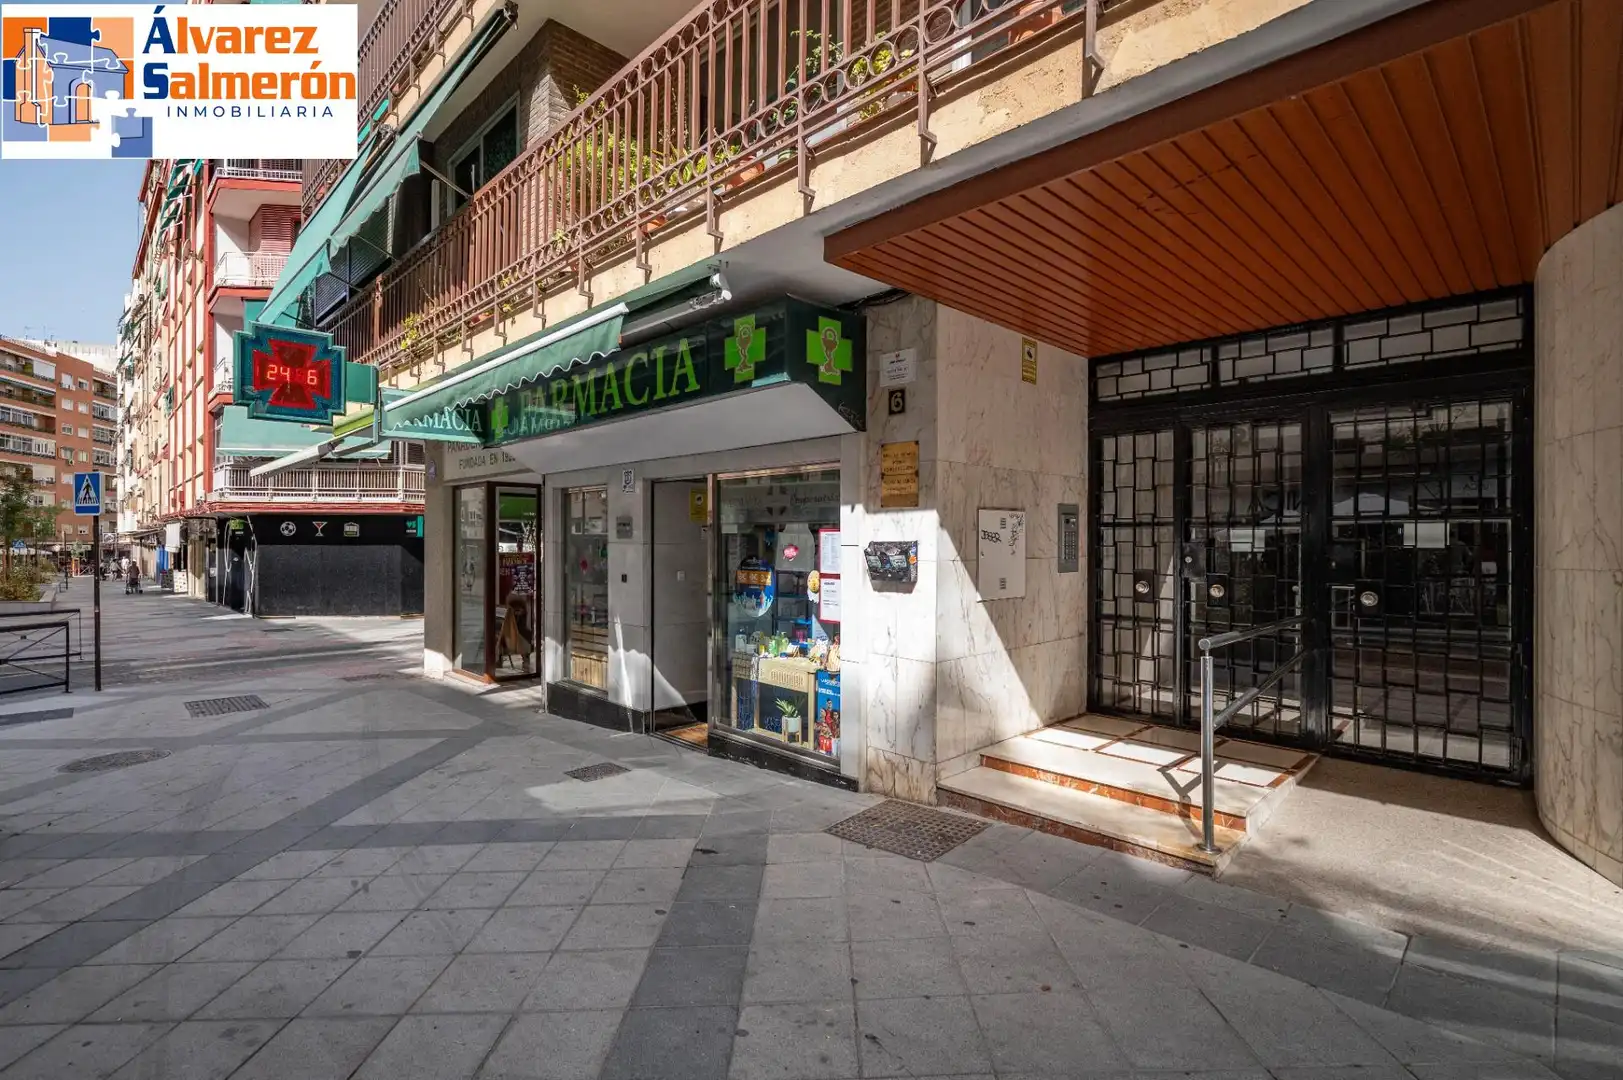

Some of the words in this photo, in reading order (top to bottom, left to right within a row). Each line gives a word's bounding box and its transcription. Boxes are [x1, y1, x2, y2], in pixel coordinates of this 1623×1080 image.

[266, 364, 290, 383] 24
[307, 369, 317, 385] 6
[519, 337, 701, 431] FARMACIA
[890, 391, 903, 412] 6
[458, 455, 486, 470] FUNDADA
[489, 451, 498, 465] EN
